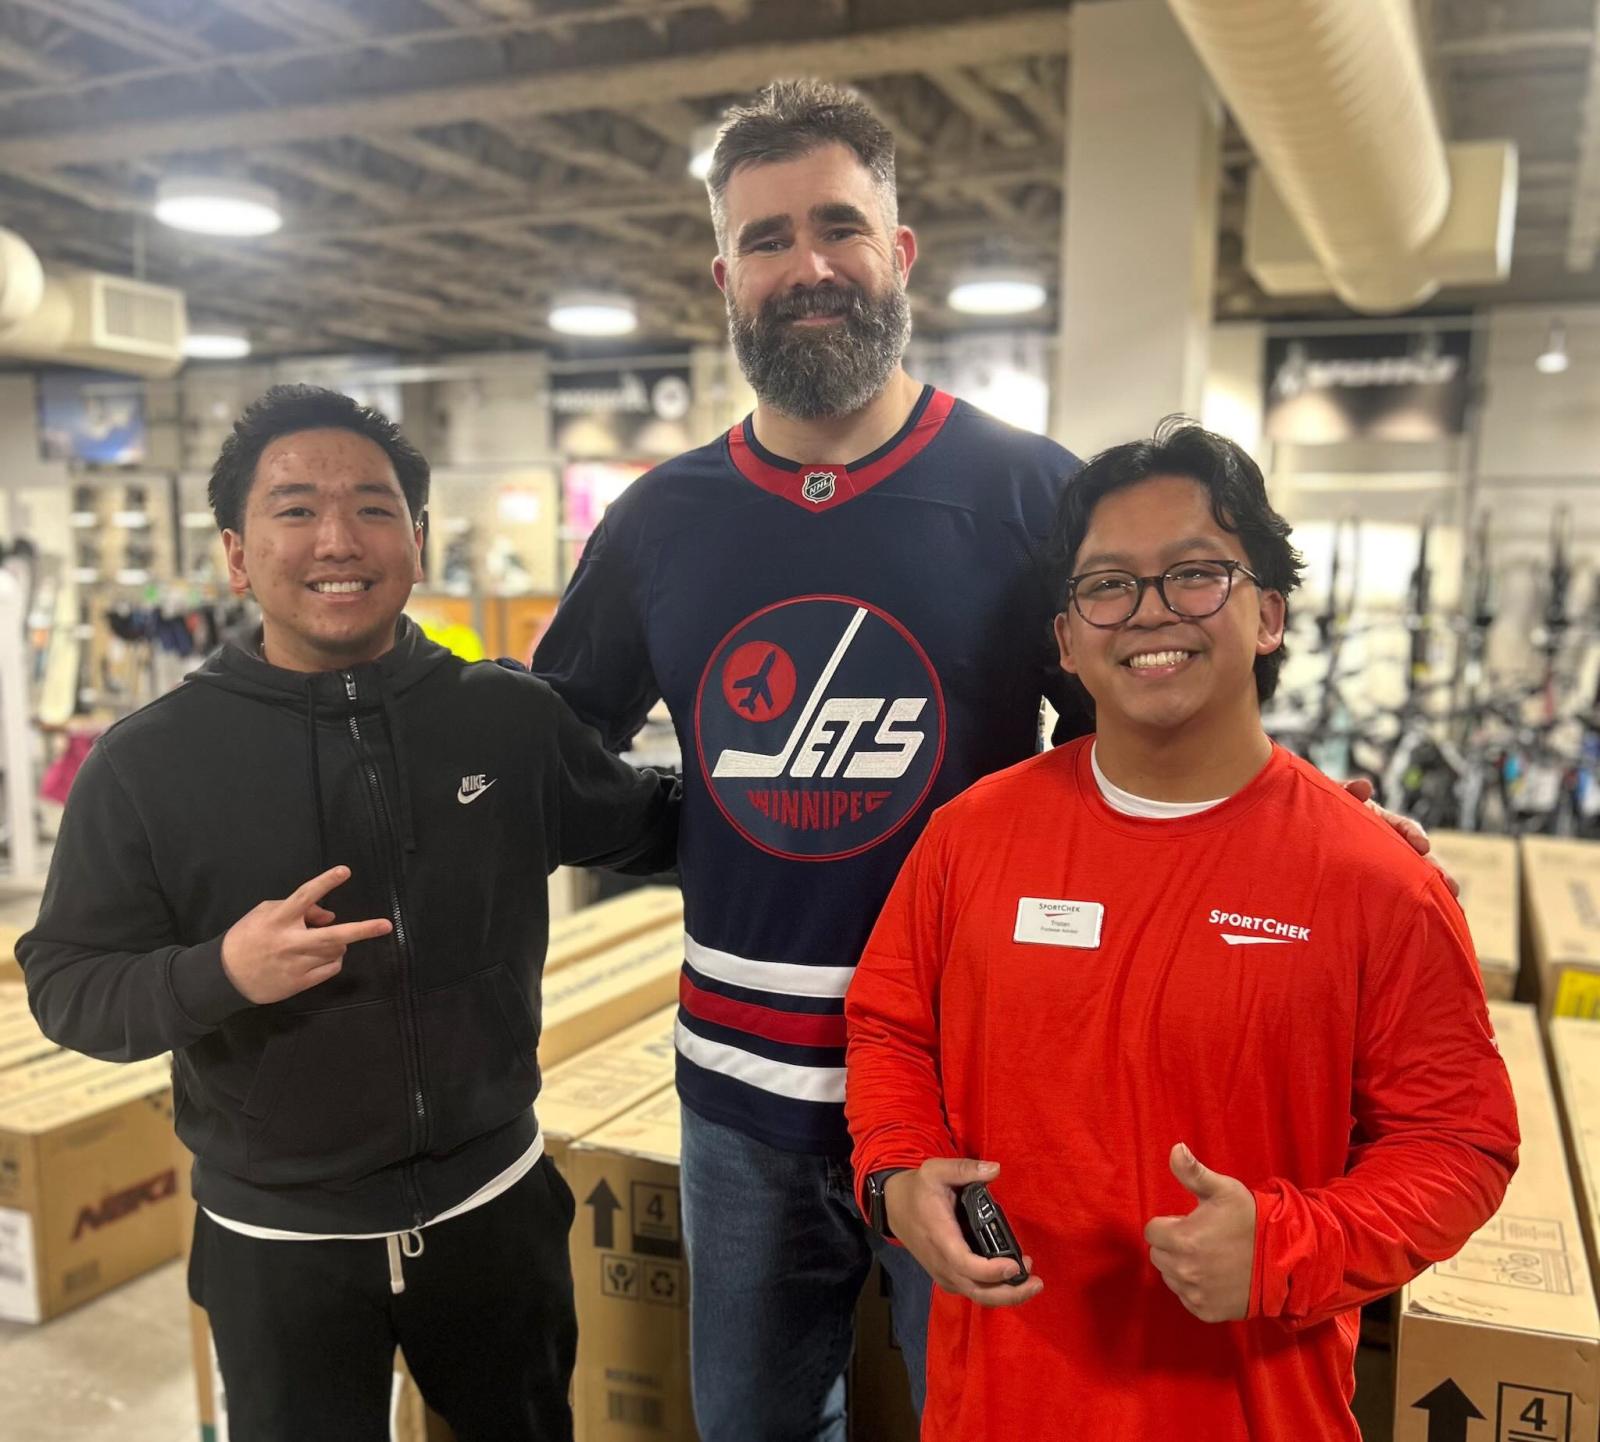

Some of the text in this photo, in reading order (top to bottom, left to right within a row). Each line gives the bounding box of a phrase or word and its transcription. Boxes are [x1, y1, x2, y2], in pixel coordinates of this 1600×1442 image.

[810, 480, 829, 495] NHL
[711, 607, 928, 779] JETS
[462, 774, 486, 792] NIKE
[746, 790, 892, 831] WINNIPEG
[646, 1193, 665, 1222] 4
[1520, 1398, 1547, 1431] 4
